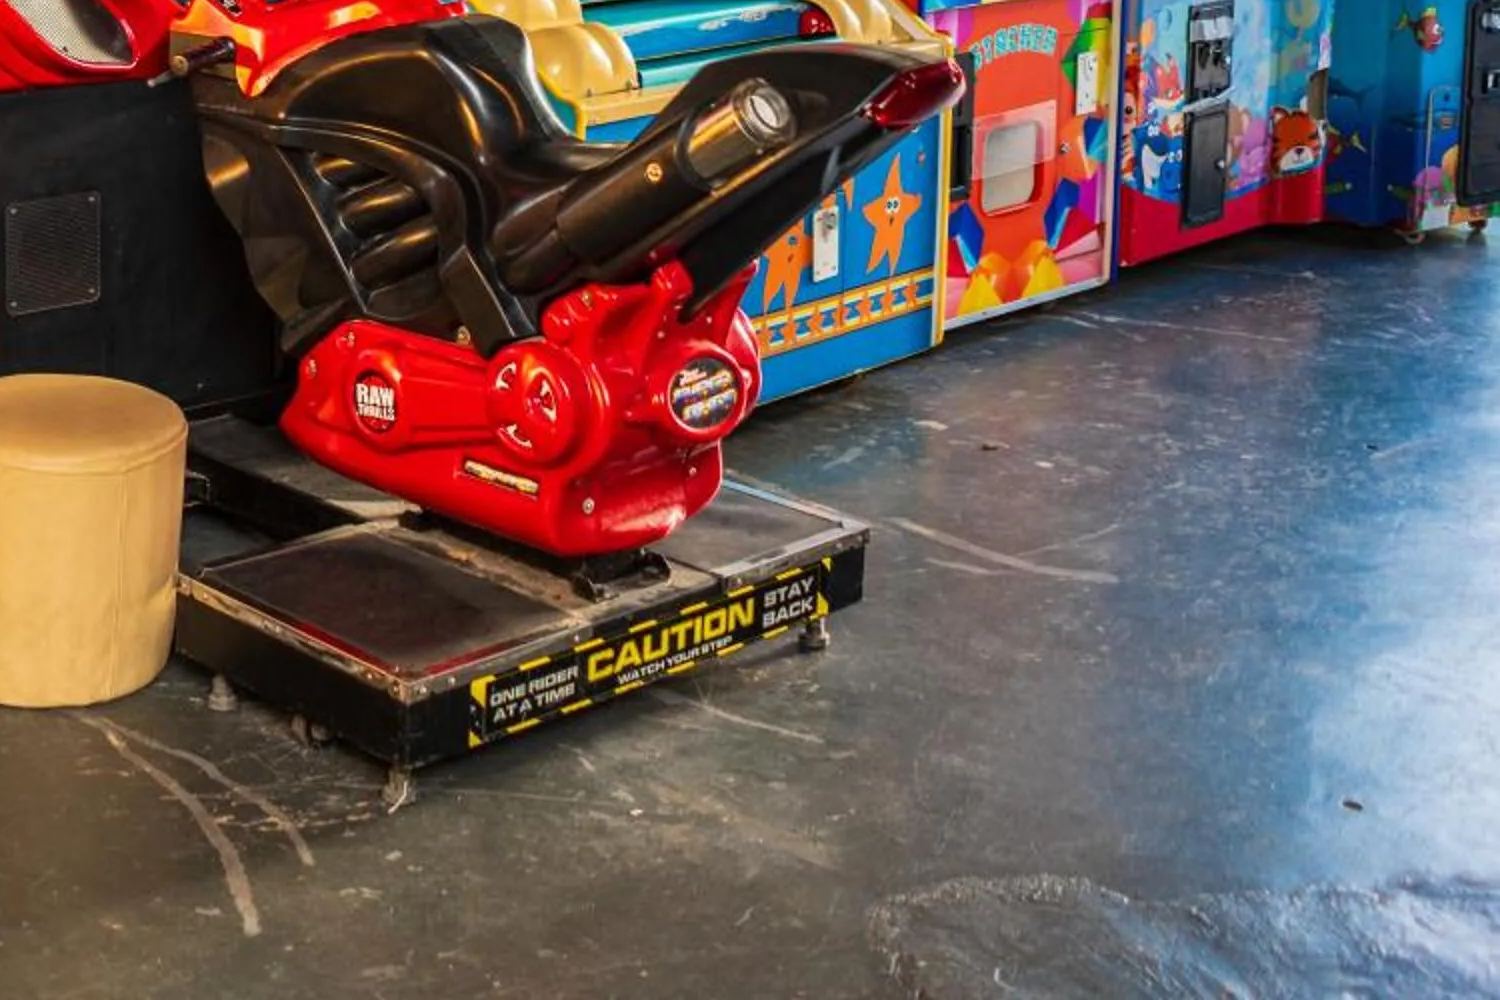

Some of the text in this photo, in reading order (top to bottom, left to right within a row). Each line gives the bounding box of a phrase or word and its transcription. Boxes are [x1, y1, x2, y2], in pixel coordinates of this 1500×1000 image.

[356, 383, 395, 410] RAW
[764, 577, 814, 608] STAY
[763, 597, 814, 628] BACK
[587, 598, 755, 683] CAUTION
[617, 635, 733, 685] WATCH YOUR STEP
[490, 665, 579, 707] ONE RIDER
[534, 683, 576, 707] TIME
